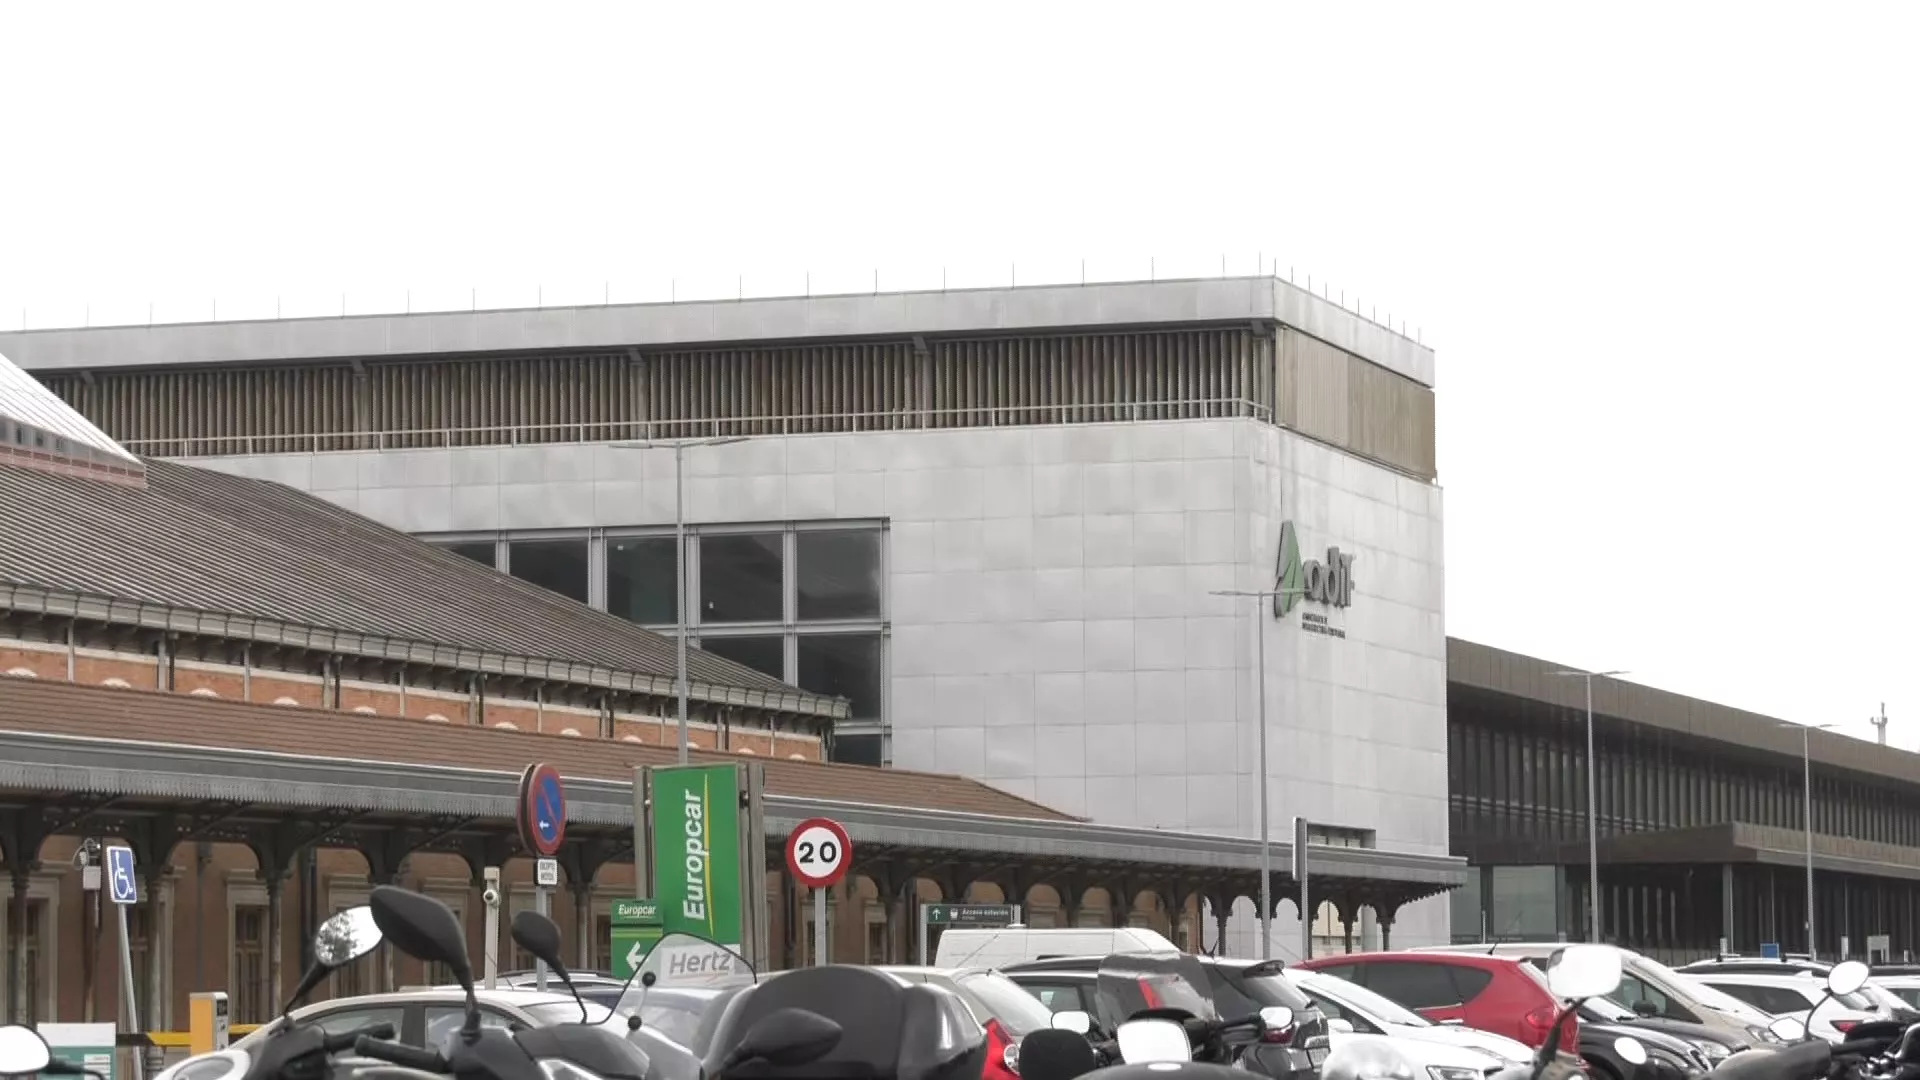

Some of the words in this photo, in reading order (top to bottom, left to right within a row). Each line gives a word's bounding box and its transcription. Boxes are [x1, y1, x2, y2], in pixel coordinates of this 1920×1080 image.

[683, 788, 709, 920] Europcar
[799, 841, 838, 864] 20
[618, 904, 656, 918] Europcar
[669, 952, 731, 974] Hertz
